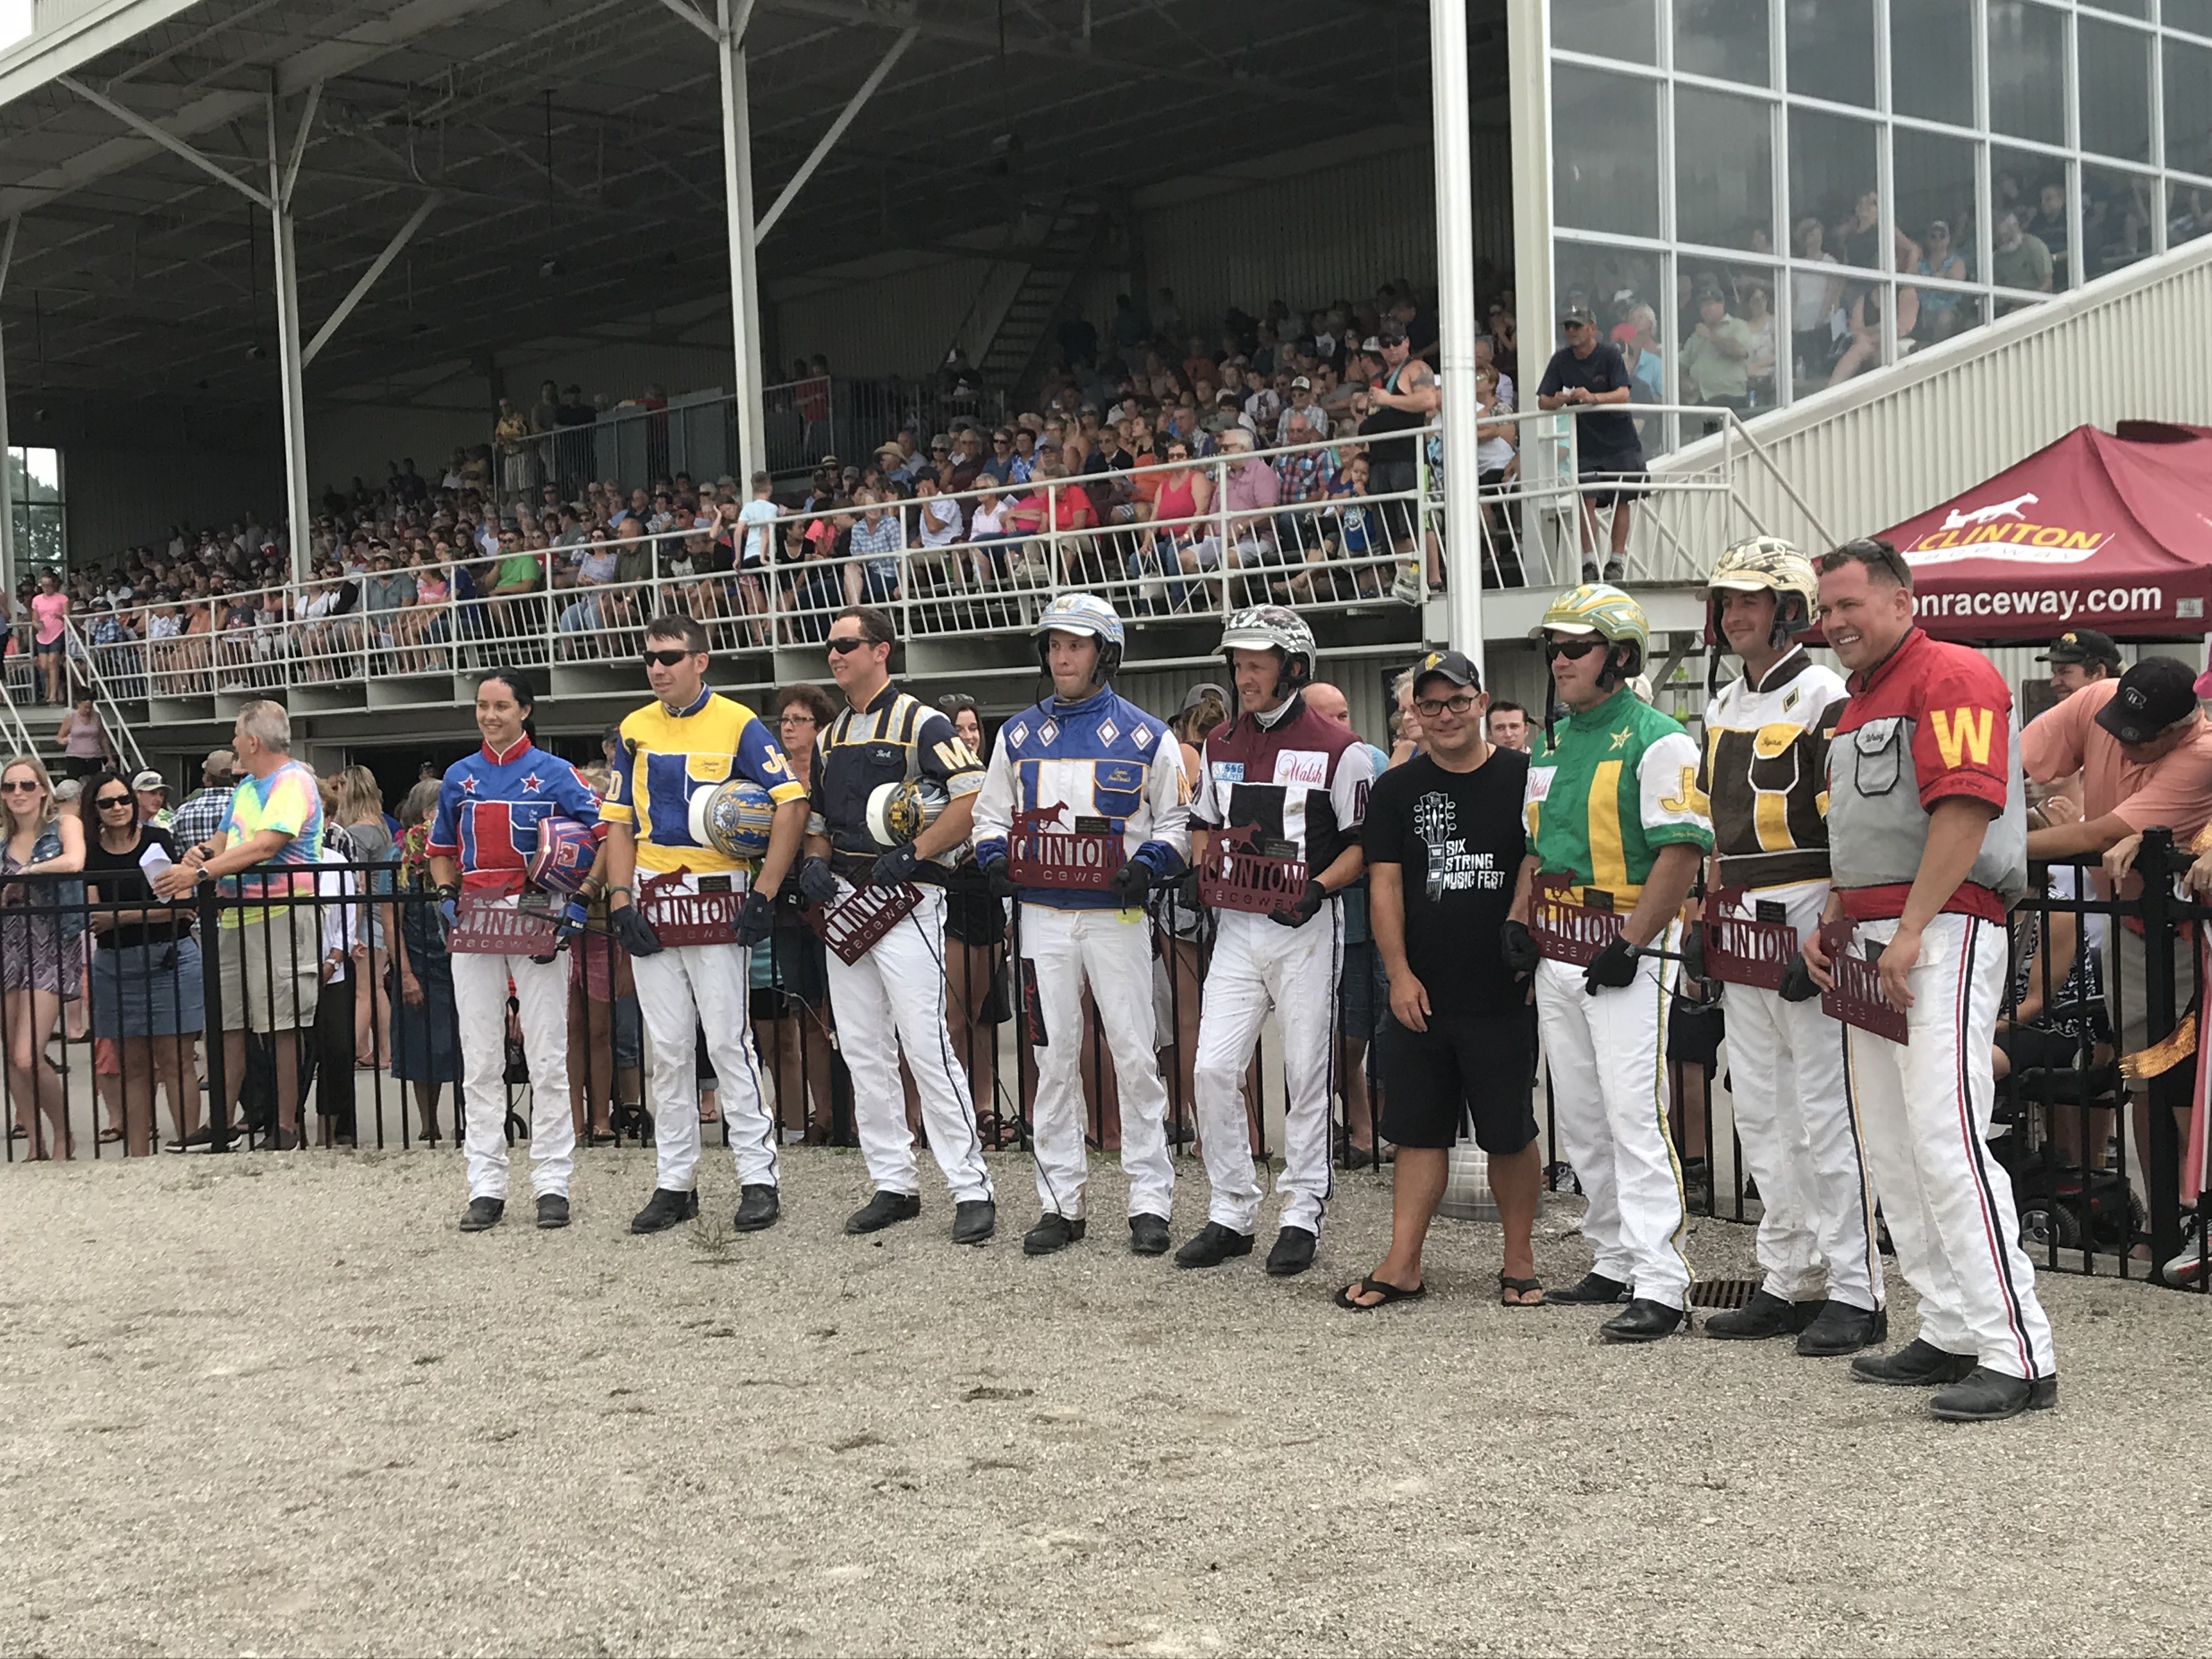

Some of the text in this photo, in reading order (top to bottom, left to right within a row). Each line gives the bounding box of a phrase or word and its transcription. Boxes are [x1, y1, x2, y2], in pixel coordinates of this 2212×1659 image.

[1918, 522, 2102, 551] CLINTON
[1930, 707, 1994, 769] W
[1278, 752, 1324, 783] Walsh
[1014, 835, 1118, 868] CLINTON
[1444, 854, 1494, 871] STRING
[1446, 838, 1466, 856] SIX
[1205, 854, 1305, 895] CLINTON
[1443, 871, 1505, 890] MUSIC FEST
[643, 895, 741, 928] CLINTON
[844, 890, 916, 957] raceway
[453, 938, 550, 951] raceway
